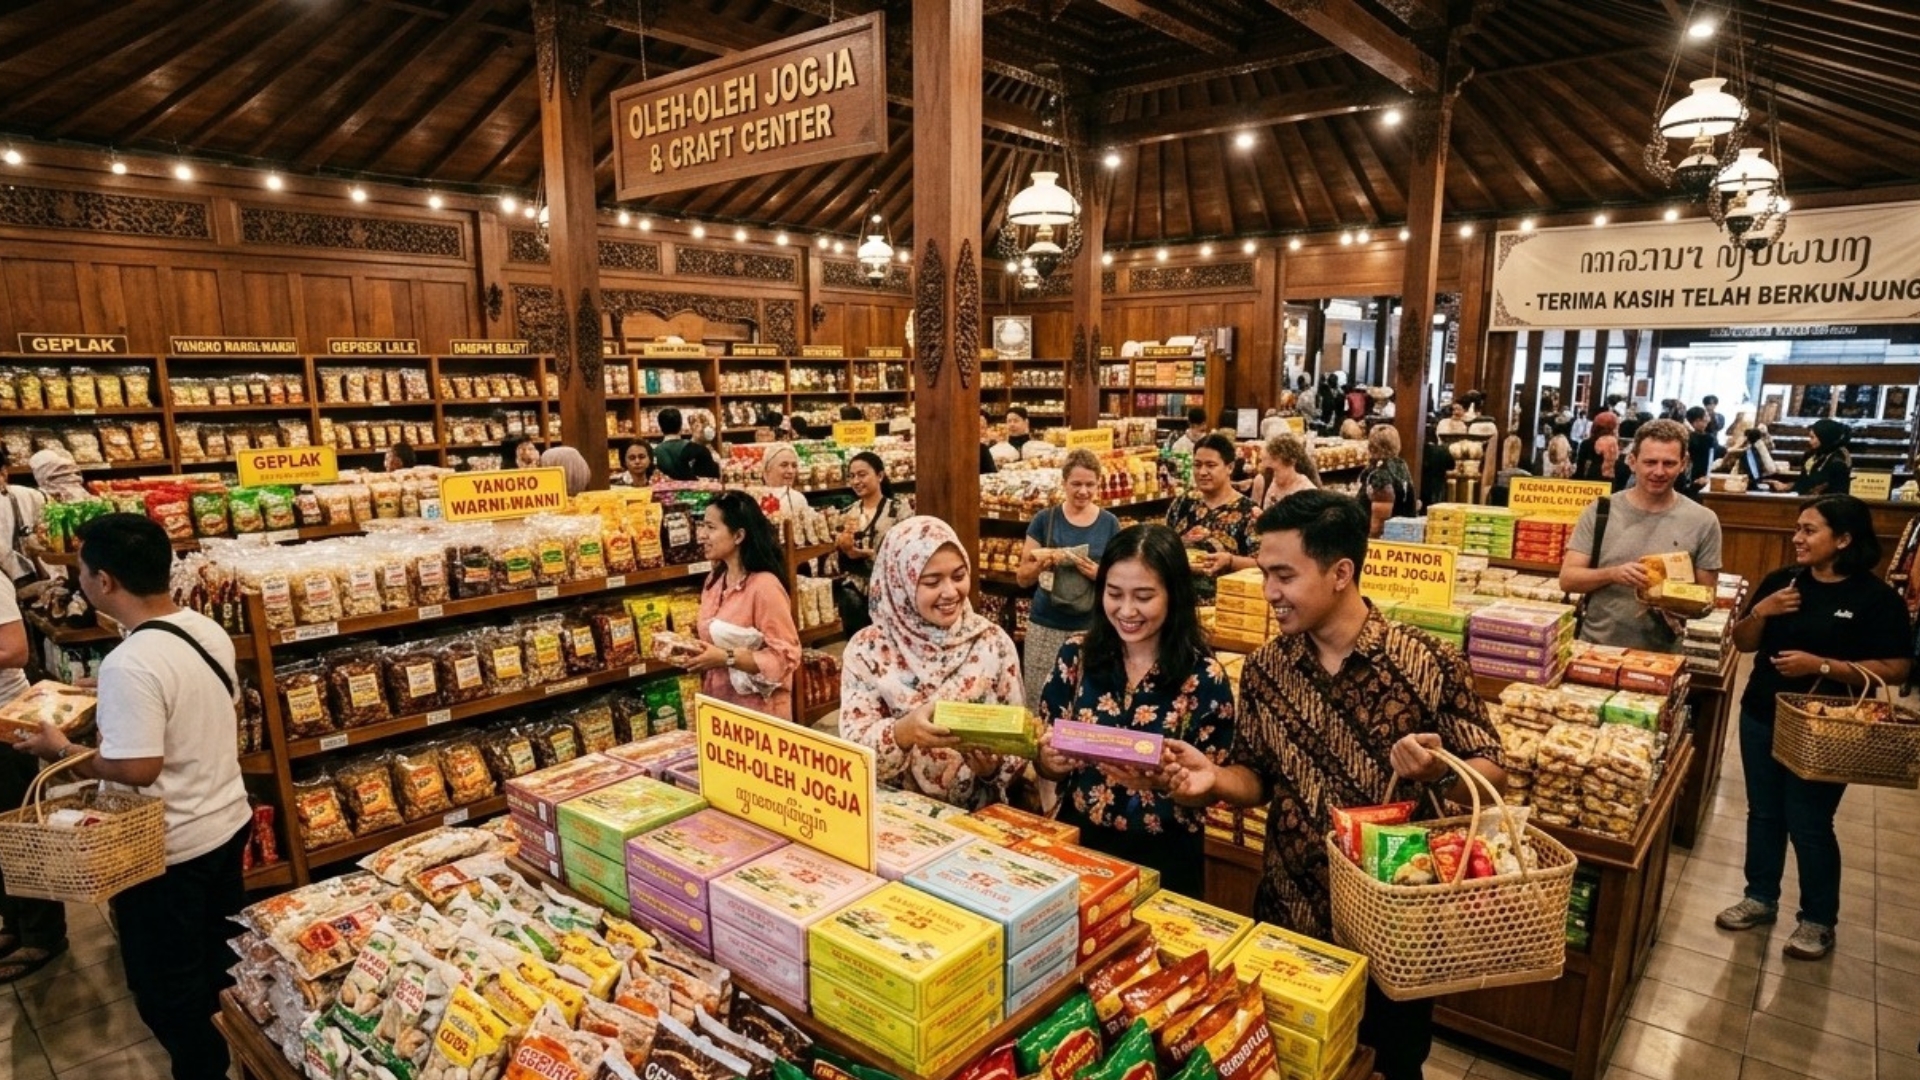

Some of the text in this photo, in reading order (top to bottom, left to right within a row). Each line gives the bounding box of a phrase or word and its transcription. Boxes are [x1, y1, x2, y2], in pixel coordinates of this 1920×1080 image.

[628, 47, 857, 140] OLEH-OLEH JOGJA
[650, 103, 834, 174] & CRAFT CENTER
[1536, 288, 1607, 311] TERIMA
[1612, 287, 1675, 309] KASIH
[1681, 284, 1751, 308] TELAH
[1757, 278, 1920, 306] BERKUNJUNG
[32, 337, 116, 353] GEPLAK
[253, 452, 322, 469] GEPLAK
[1401, 567, 1446, 583] JOGJA
[711, 715, 853, 782] BAKPIA PATHOK
[706, 742, 796, 791] OLEH-OLEH
[801, 776, 862, 817] JOGJA
